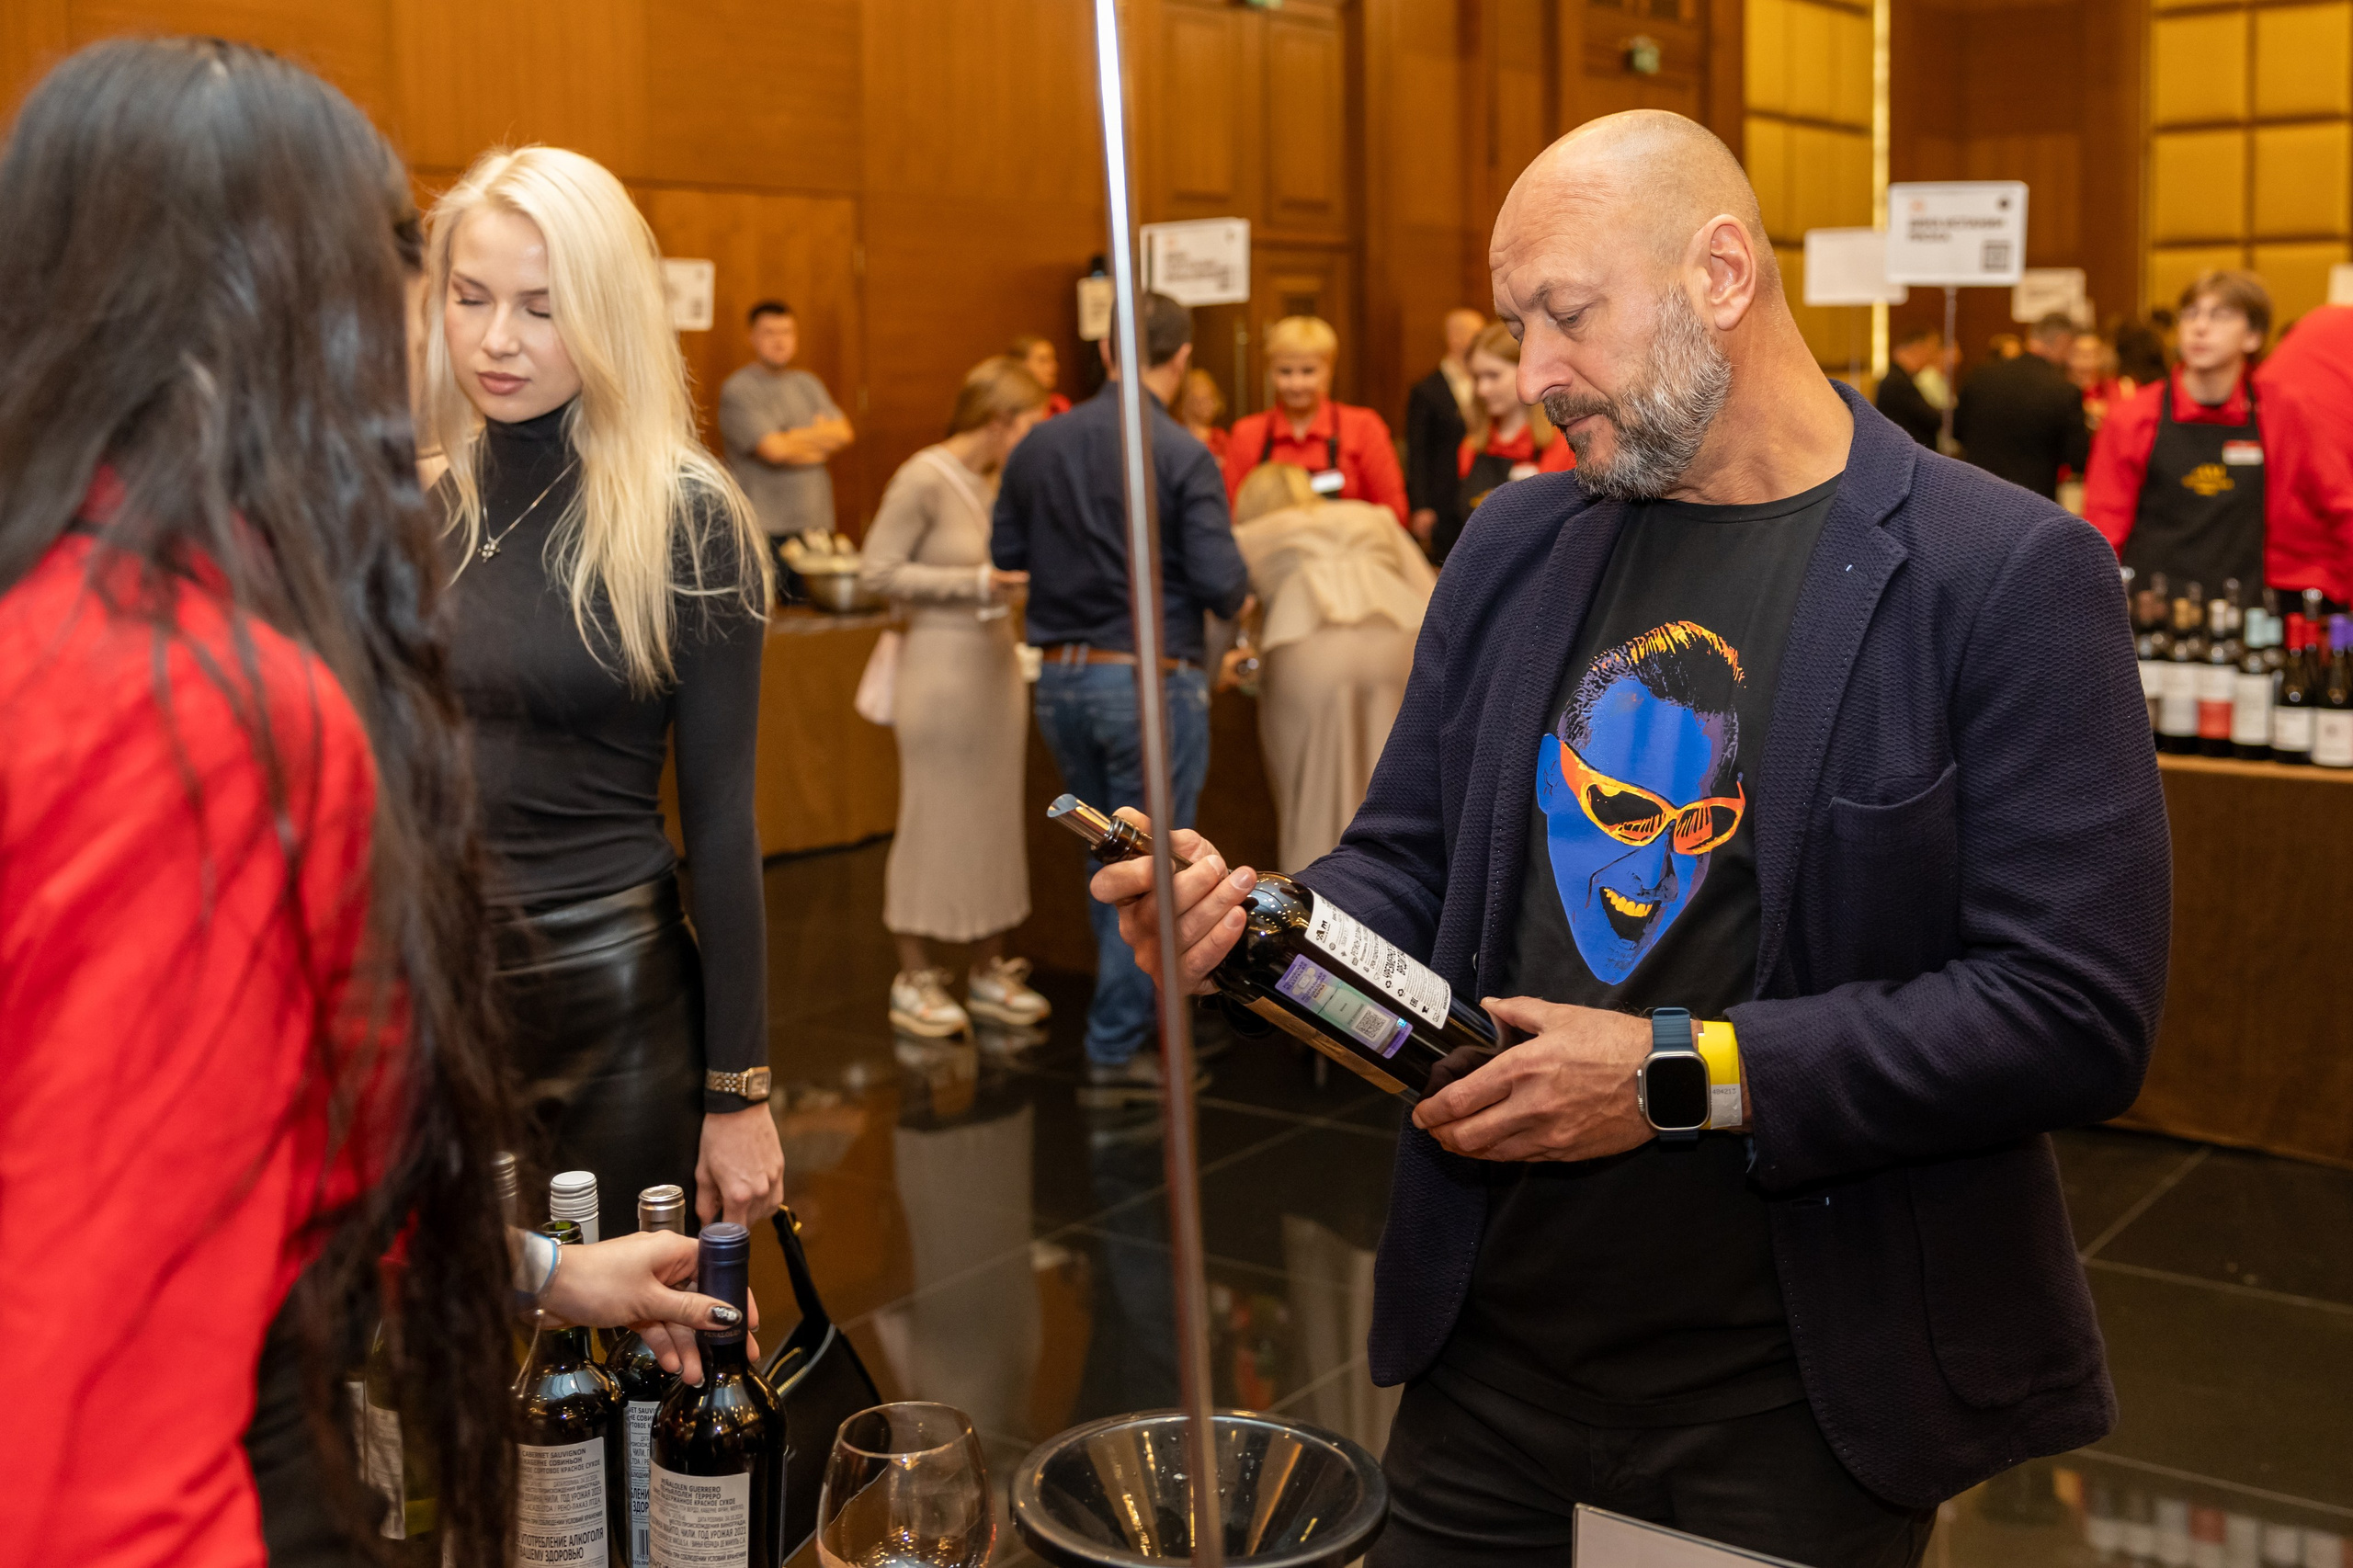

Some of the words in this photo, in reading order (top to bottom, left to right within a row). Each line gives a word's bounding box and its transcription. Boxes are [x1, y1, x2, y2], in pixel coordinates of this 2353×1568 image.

[1313, 983, 1324, 999] МАРКА
[522, 1450, 549, 1459] CABERNET
[551, 1448, 586, 1459] SAUVIGNON
[549, 1457, 582, 1466] СОВИНЬОН
[561, 1464, 584, 1473] КРАСНОЕ
[585, 1459, 600, 1469] СУХОЕ
[561, 1494, 571, 1503] ГОД
[571, 1489, 590, 1501] УРОЖАЯ
[688, 1485, 721, 1494] GUERRERO
[719, 1497, 735, 1506] СУХОЕ
[521, 1533, 567, 1548] УПОТРЕБЛЕНИЕ
[569, 1527, 604, 1547] АЛКОГОЛЯ
[699, 1530, 709, 1540] ГОД
[710, 1528, 733, 1539] УРОЖАЯ
[545, 1547, 584, 1564] ЗДОРОВЬЮ
